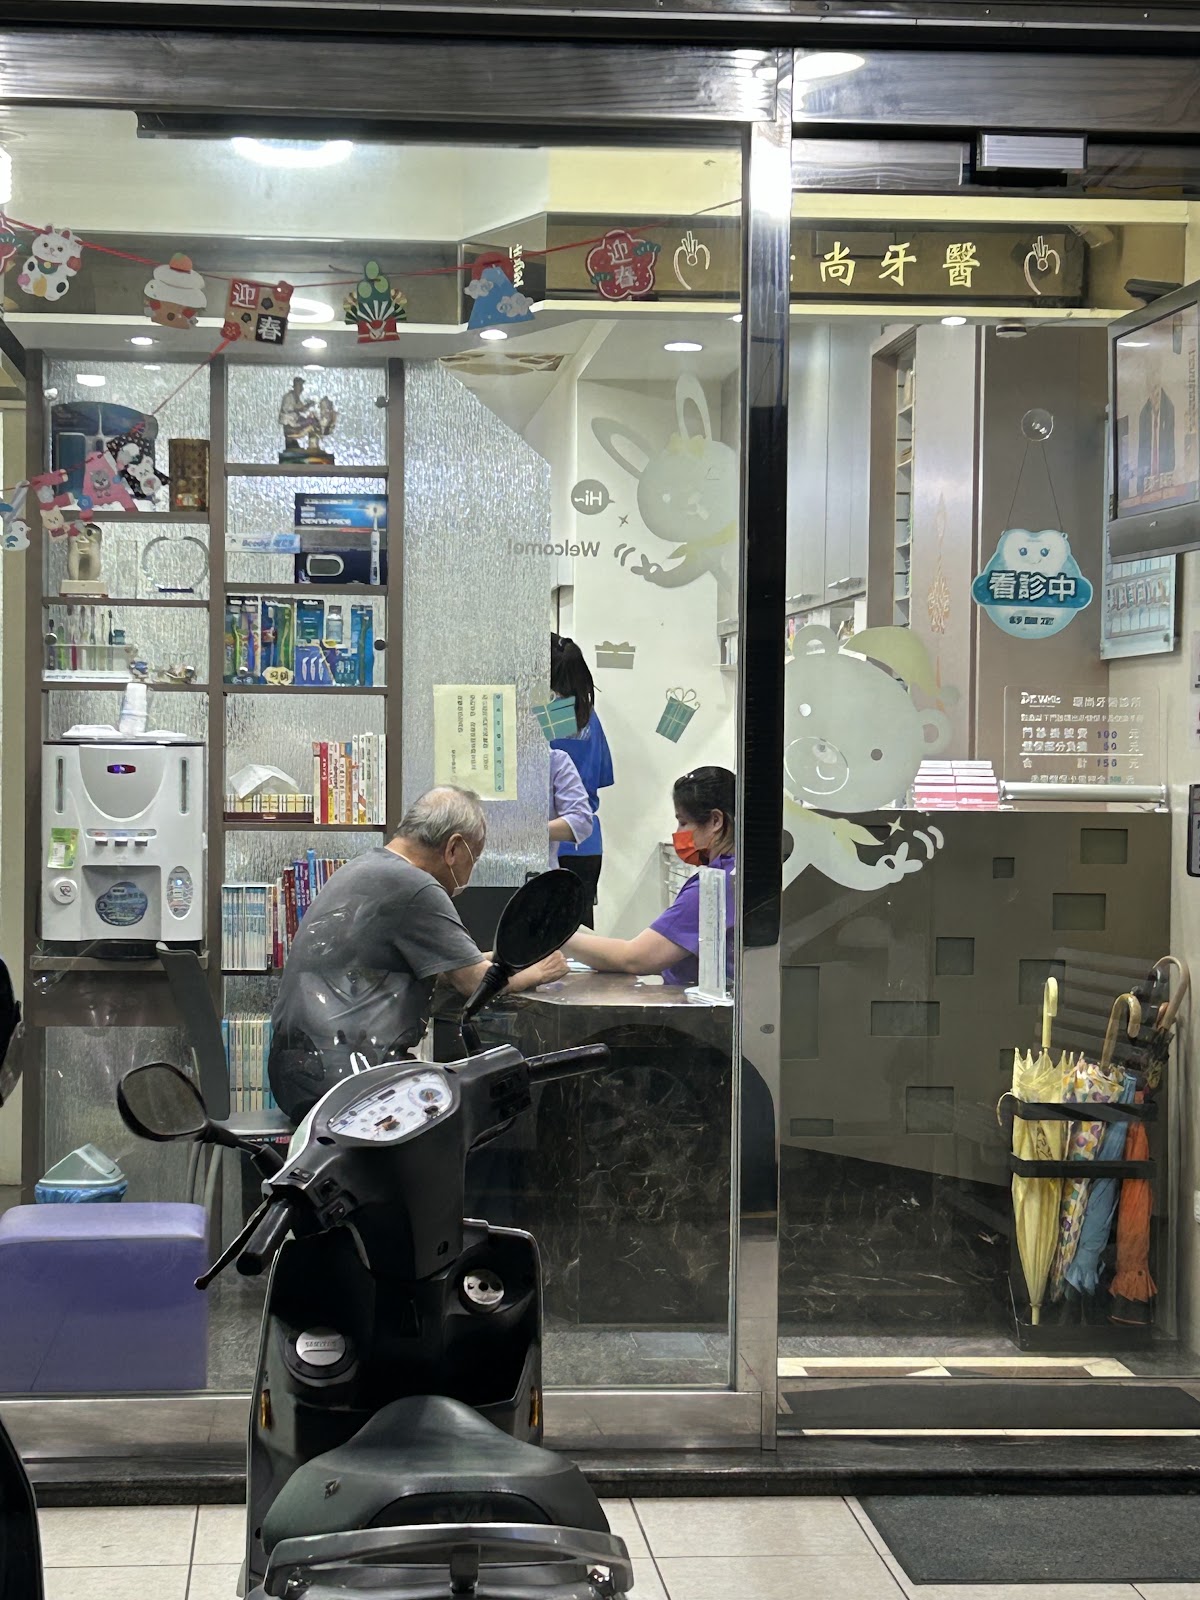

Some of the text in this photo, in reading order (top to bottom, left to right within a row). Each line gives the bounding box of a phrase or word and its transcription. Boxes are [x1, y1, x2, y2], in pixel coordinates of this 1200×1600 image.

[607, 239, 638, 289] 迎春
[790, 241, 981, 288] 尚牙醫
[988, 571, 1077, 602] 看診中
